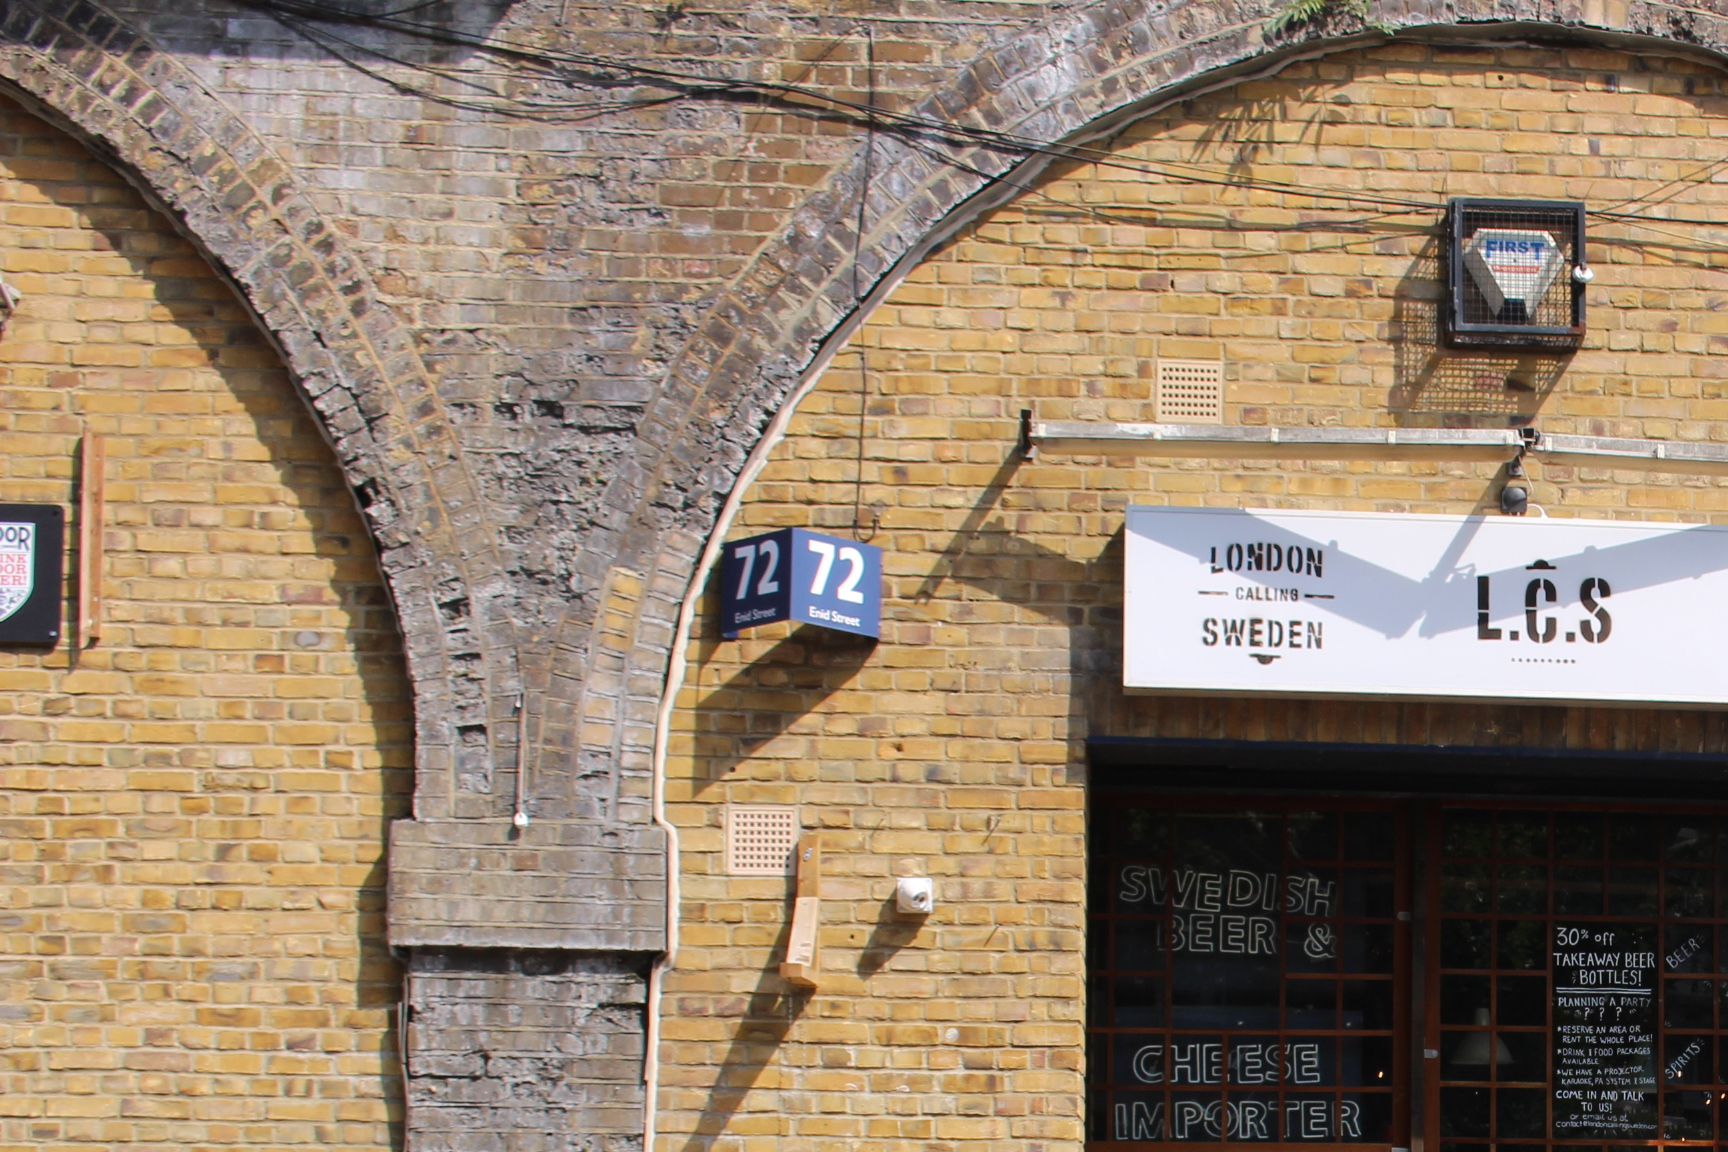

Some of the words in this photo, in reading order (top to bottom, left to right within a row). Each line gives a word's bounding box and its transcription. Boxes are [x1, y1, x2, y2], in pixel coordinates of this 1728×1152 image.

[1486, 240, 1544, 260] FIRST
[735, 539, 780, 600] 72
[1210, 542, 1323, 578] LONDON
[808, 539, 864, 604] 72
[1235, 586, 1299, 602] CALLING
[735, 611, 751, 624] Enid
[752, 607, 776, 620] Street
[809, 605, 831, 620] Enid
[831, 611, 861, 627] Street
[1477, 576, 1612, 643] L.C.S
[1202, 617, 1323, 649] SWEDEN
[1119, 865, 1336, 918] SWEDISH
[1157, 914, 1277, 955] BEER
[1304, 922, 1337, 959] &
[1557, 927, 1589, 946] 30%
[1594, 932, 1615, 946] off
[1553, 952, 1620, 967] TAKEAWAY
[1625, 952, 1655, 968] BEER
[1665, 938, 1701, 970] BEER
[1579, 969, 1642, 987] BOTTLES!
[1558, 997, 1605, 1007] PLANNING
[1609, 997, 1616, 1007] A
[1620, 997, 1652, 1008] PARTY
[1562, 1025, 1594, 1034] RESERVE
[1595, 1026, 1606, 1034] AN
[1629, 1025, 1641, 1033] OR
[1562, 1035, 1581, 1043] RENT
[1600, 1036, 1625, 1044] WHOLE
[1628, 1034, 1653, 1043] PLACE!
[1562, 1048, 1585, 1057] DRINK
[1594, 1048, 1613, 1056] FOOD
[1616, 1047, 1651, 1055] PACKAGES
[1664, 1042, 1701, 1080] SPIRITS
[1132, 1043, 1322, 1084] CHEESE
[1555, 1090, 1583, 1100] COME
[1587, 1091, 1597, 1100] IN
[1600, 1091, 1618, 1101] AND
[1621, 1091, 1644, 1101] TALK
[1580, 1102, 1593, 1112] TO
[1598, 1103, 1613, 1114] US!
[1619, 1114, 1629, 1122] at
[1114, 1100, 1362, 1140] IMPORTER
